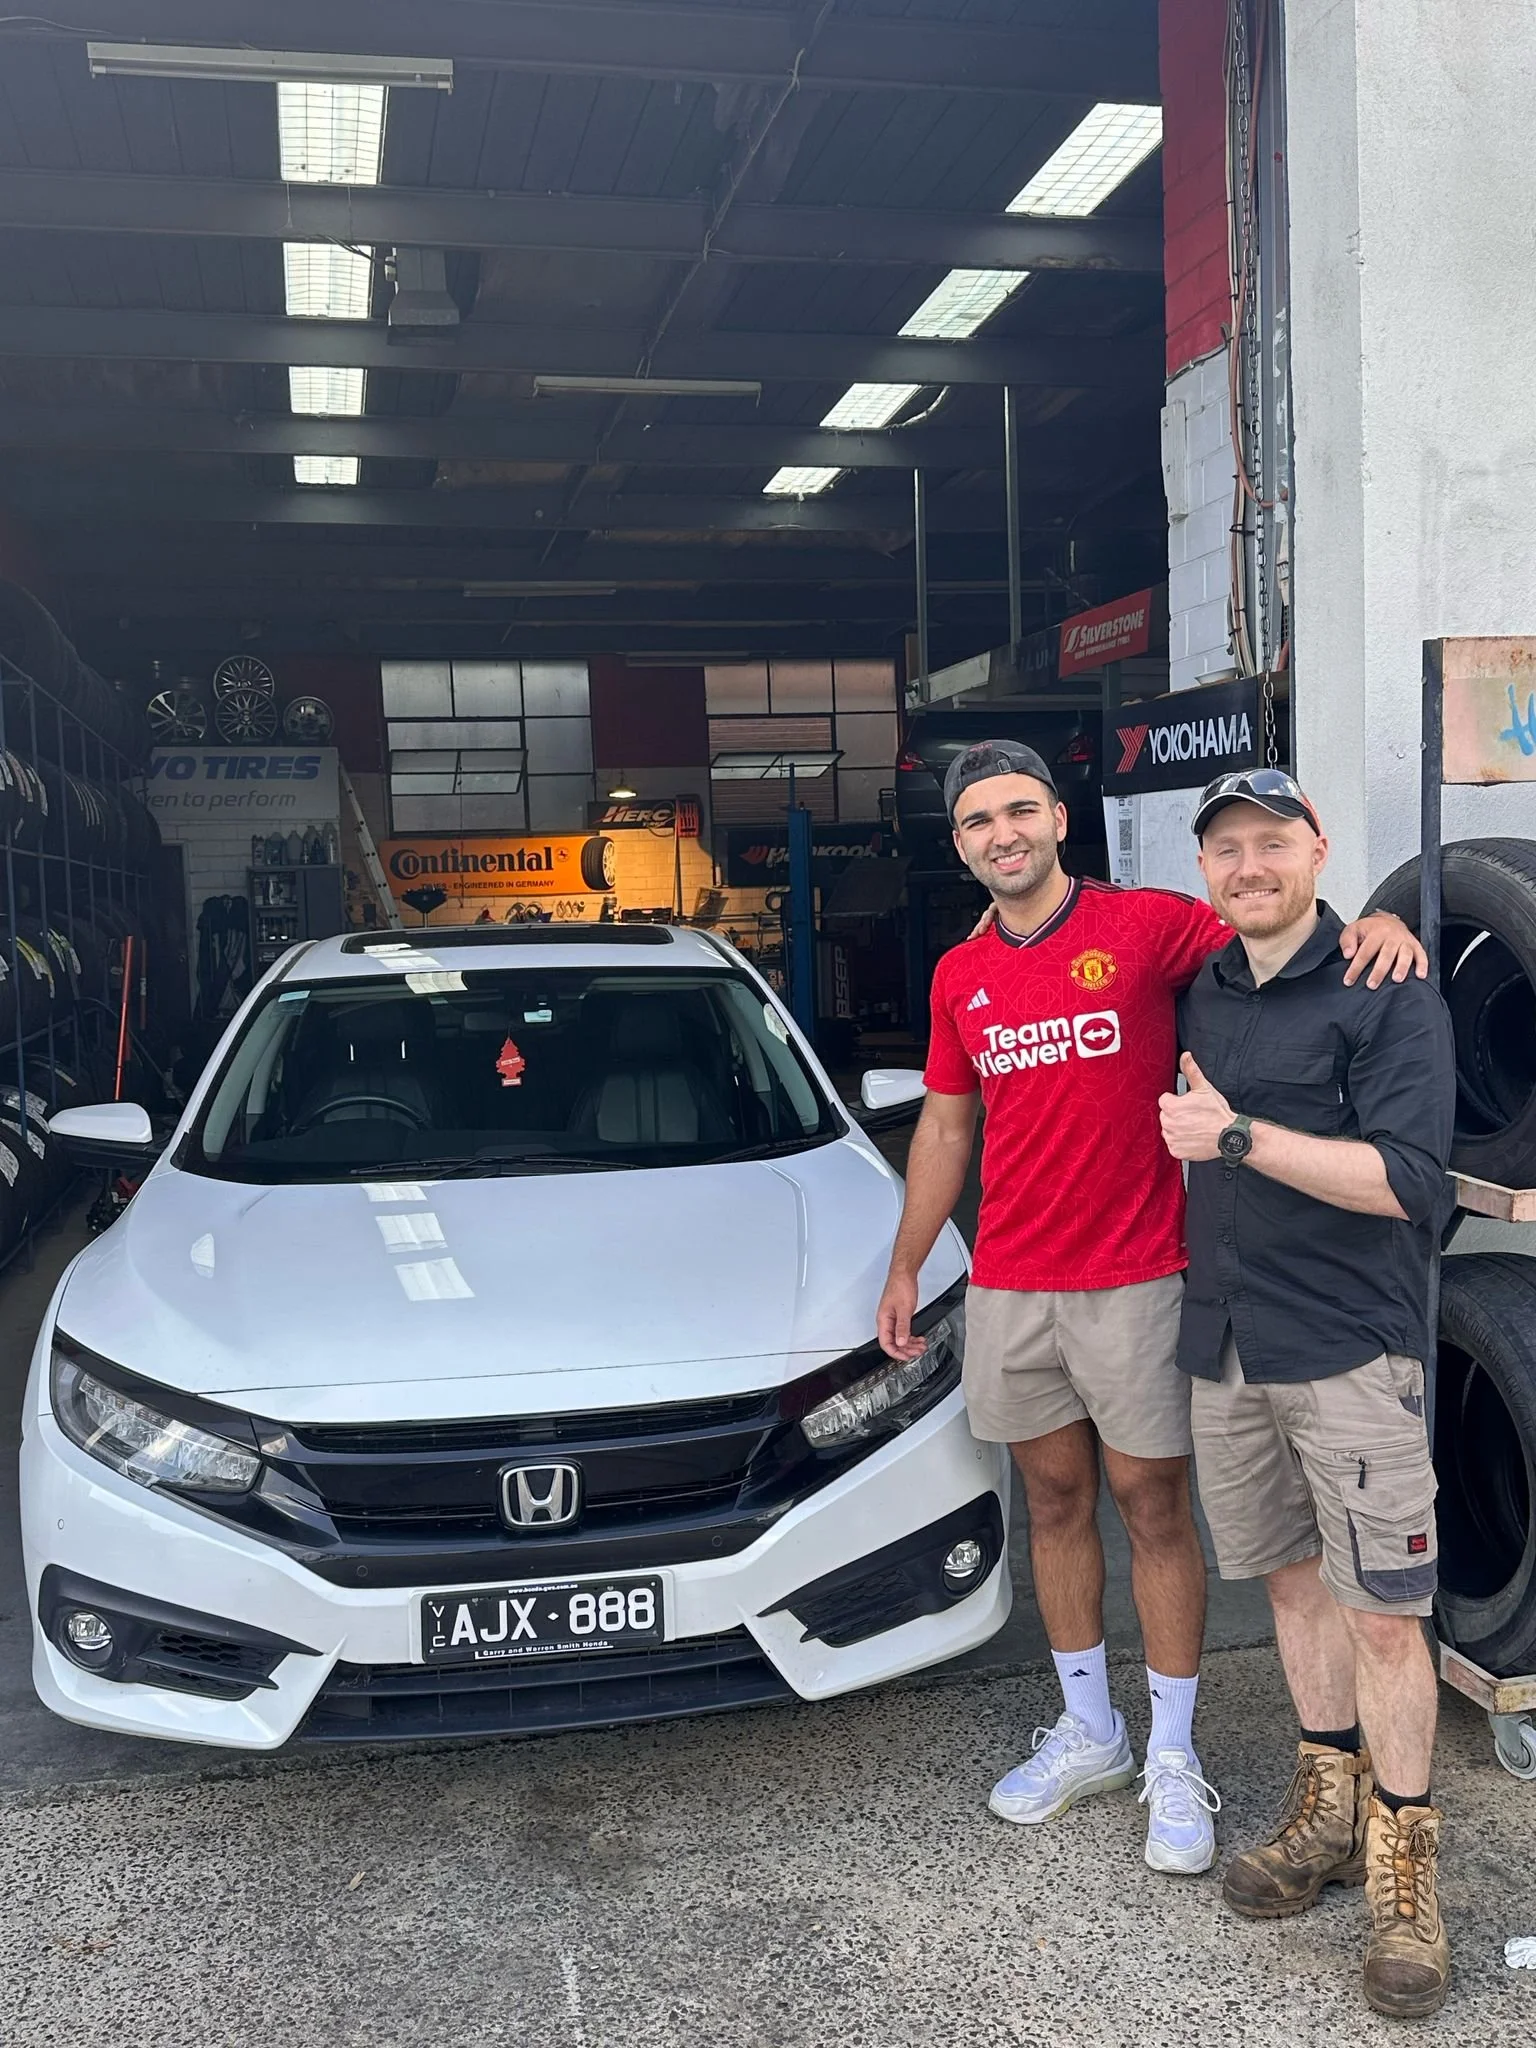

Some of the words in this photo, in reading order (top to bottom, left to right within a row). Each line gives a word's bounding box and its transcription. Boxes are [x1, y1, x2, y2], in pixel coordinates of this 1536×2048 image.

[1079, 608, 1145, 648] SILVERSTONE
[1149, 712, 1252, 764] YOKOHAMA
[203, 756, 321, 780] TIRES
[183, 792, 205, 807] to
[208, 790, 297, 812] perform
[390, 846, 554, 880] Continental
[453, 881, 504, 889] ENGINEERED
[515, 880, 554, 888] GERMANY
[983, 1017, 1071, 1053] Team
[972, 1040, 1073, 1078] Viewer
[431, 1605, 446, 1648] VIC
[450, 1597, 538, 1646] AJX
[568, 1588, 656, 1635] 888
[483, 1649, 505, 1657] Garry
[525, 1645, 555, 1653] Warren
[557, 1642, 580, 1650] Smith
[582, 1640, 608, 1648] Honda
